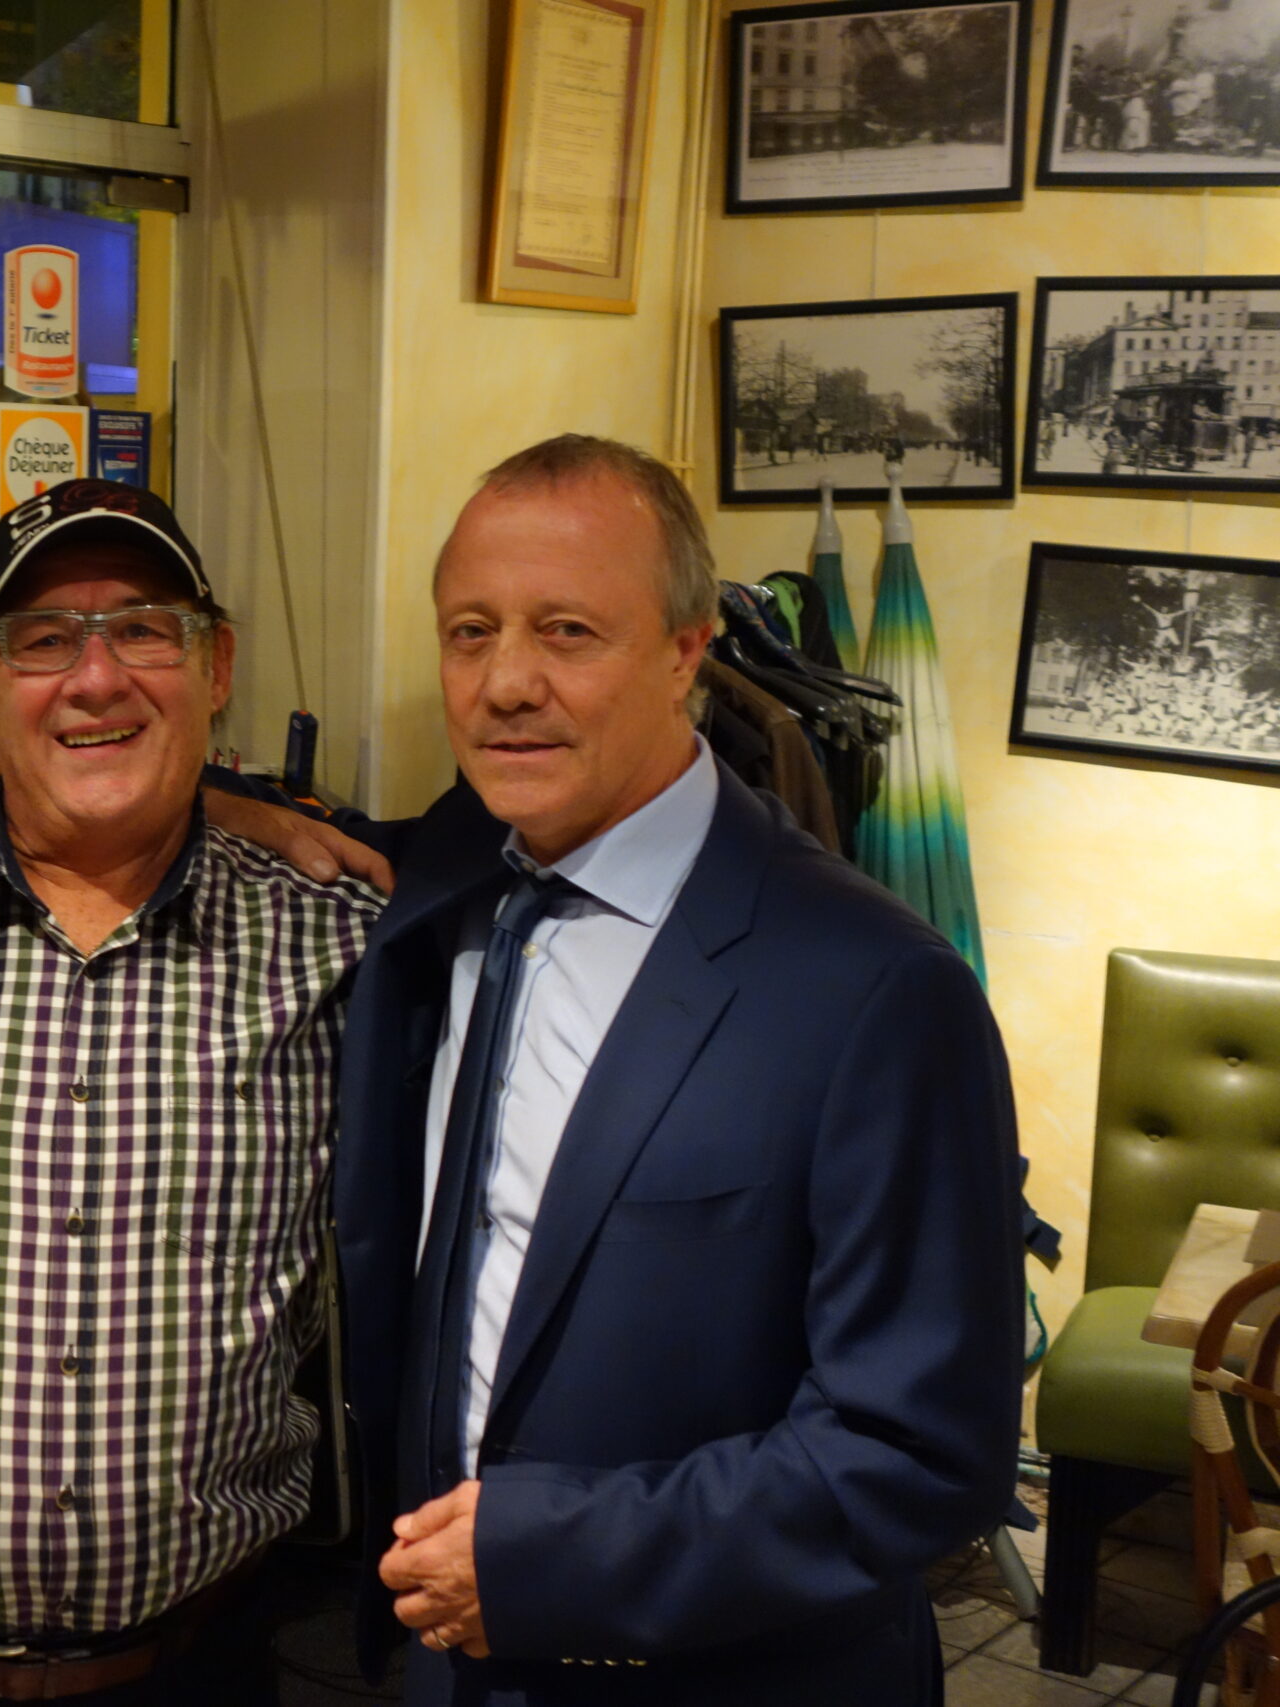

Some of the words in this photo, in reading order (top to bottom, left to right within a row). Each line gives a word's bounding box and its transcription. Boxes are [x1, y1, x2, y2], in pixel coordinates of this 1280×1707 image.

[23, 326, 71, 345] Ticket
[14, 437, 70, 458] Chèque
[9, 455, 75, 477] Déjeuner
